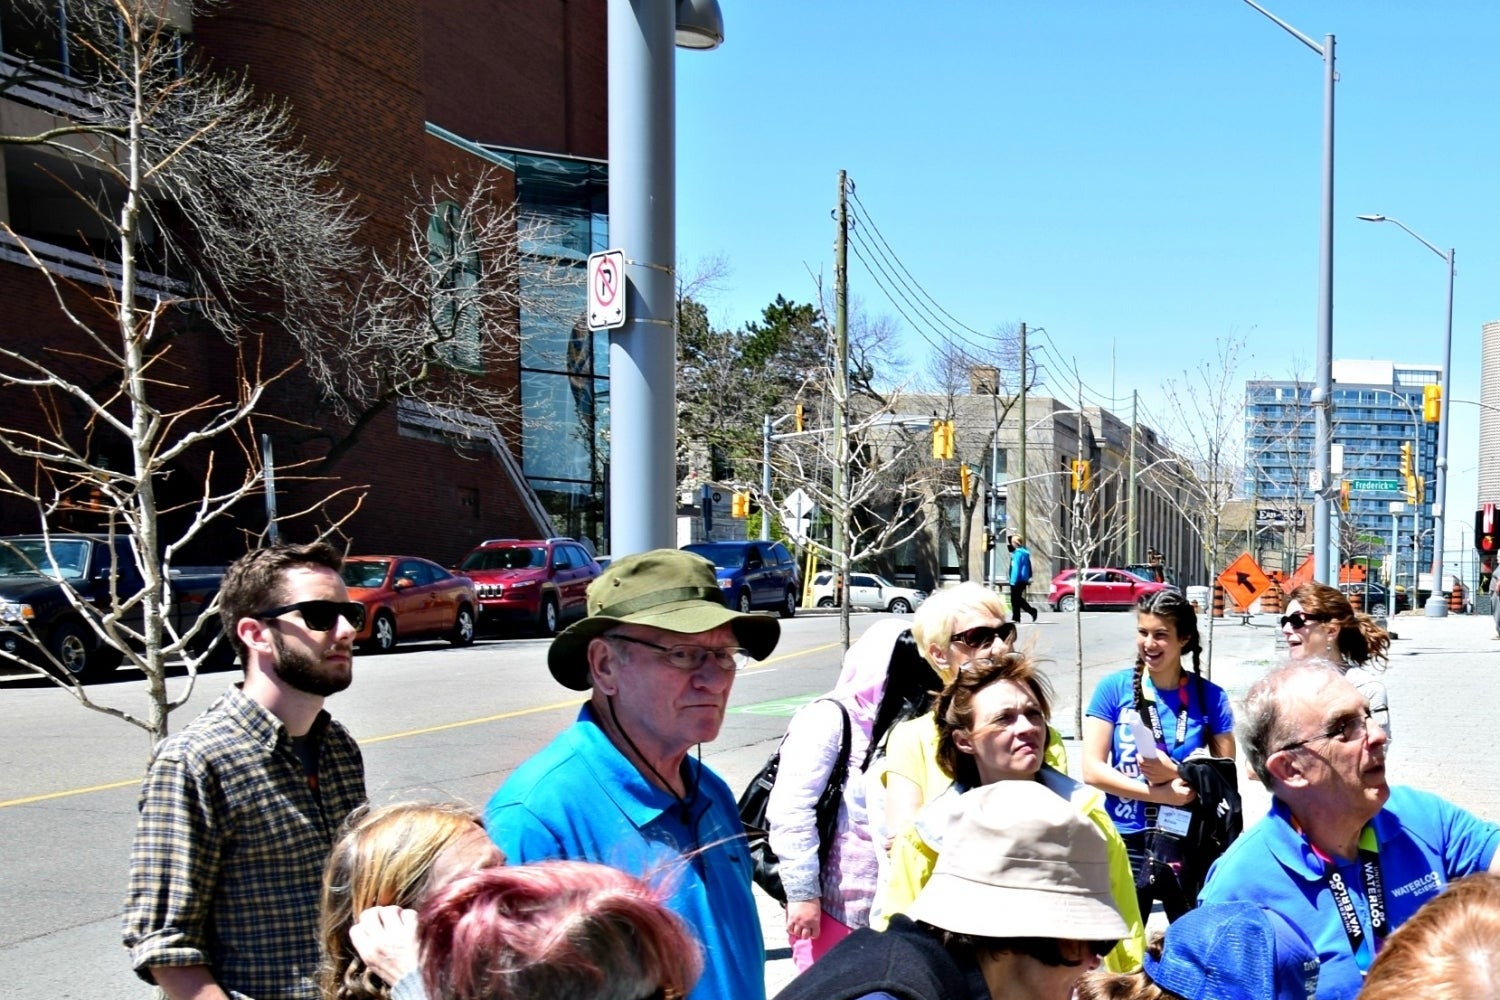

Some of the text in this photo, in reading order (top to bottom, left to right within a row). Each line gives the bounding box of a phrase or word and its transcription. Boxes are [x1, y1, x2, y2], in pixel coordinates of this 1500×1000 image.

[1355, 481, 1389, 490] Frederick
[1332, 873, 1361, 937] WATERLOO
[1364, 862, 1381, 927] WATERLOO
[1391, 871, 1439, 898] WATERLOO
